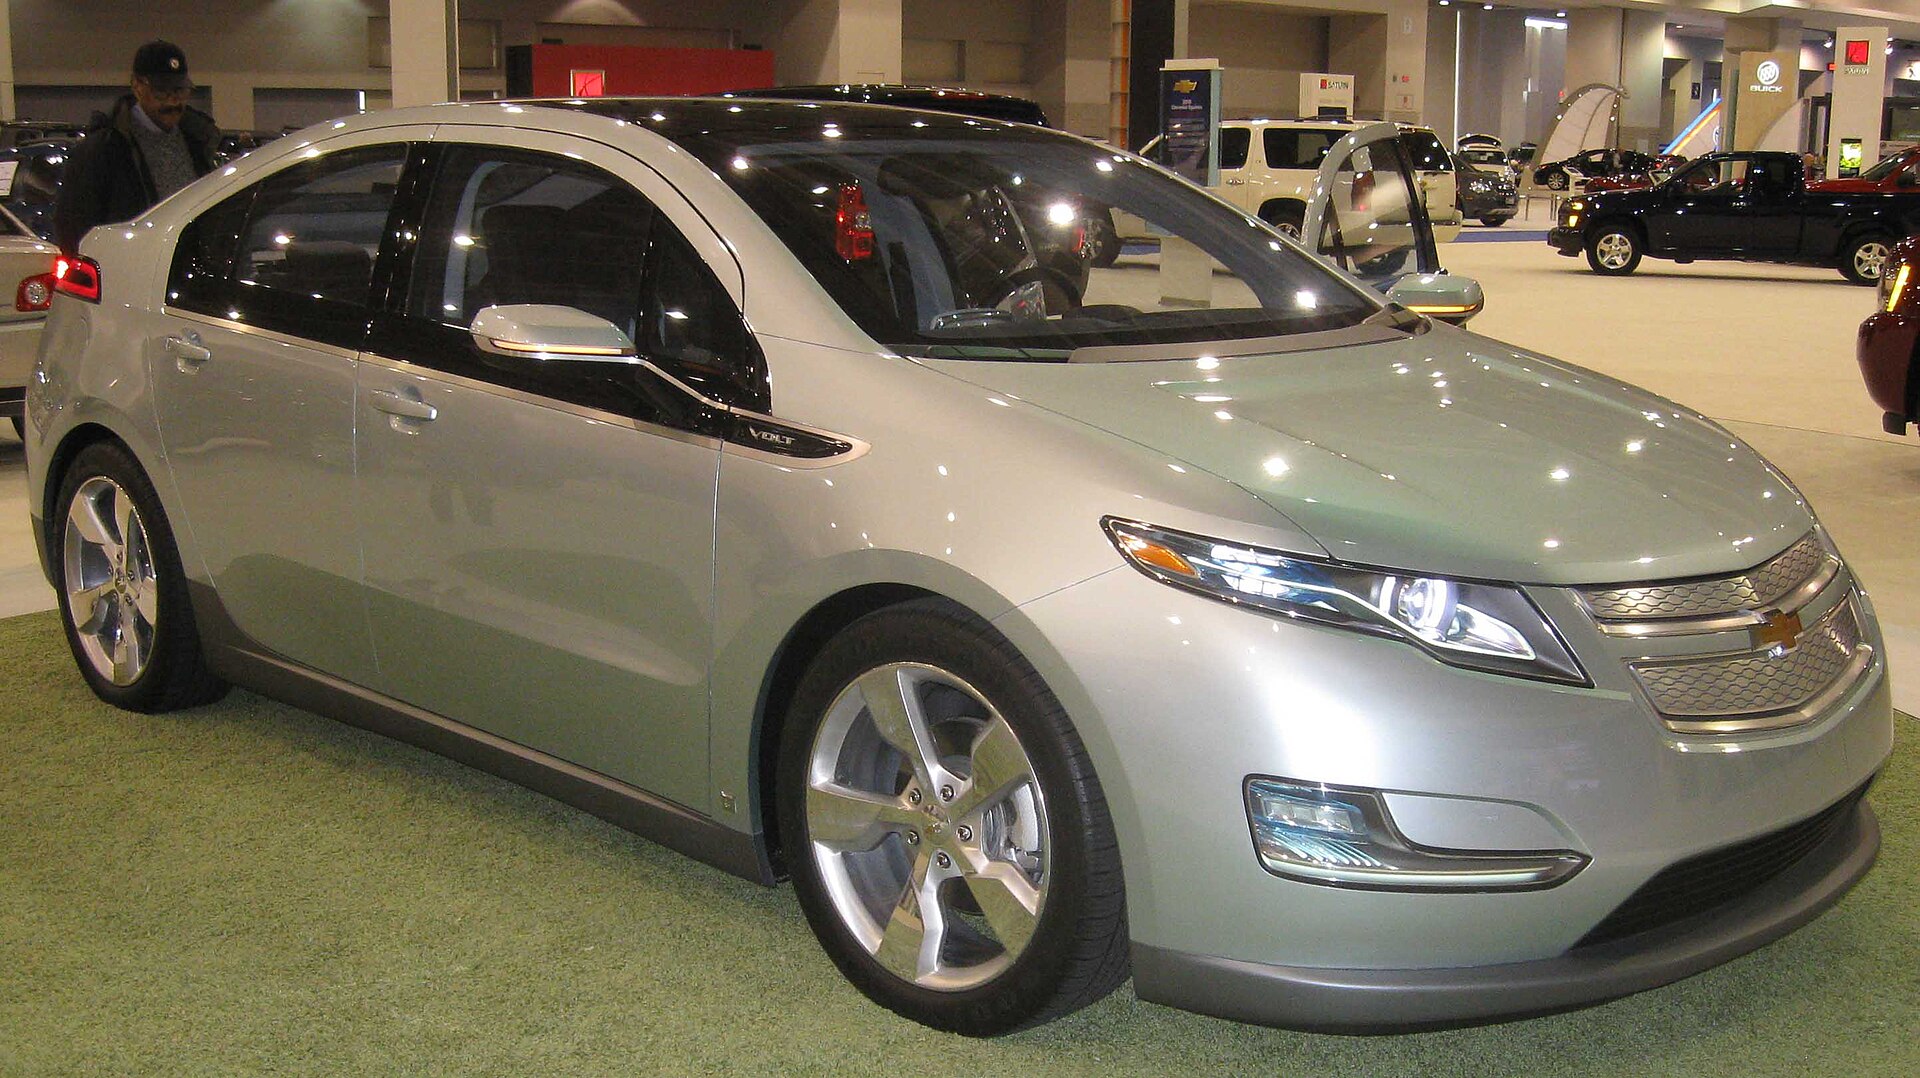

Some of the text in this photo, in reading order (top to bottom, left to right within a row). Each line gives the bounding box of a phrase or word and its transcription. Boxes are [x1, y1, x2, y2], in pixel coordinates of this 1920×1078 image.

[1328, 81, 1349, 89] SATURN
[1750, 85, 1783, 93] BUICK
[749, 426, 796, 445] VOLT
